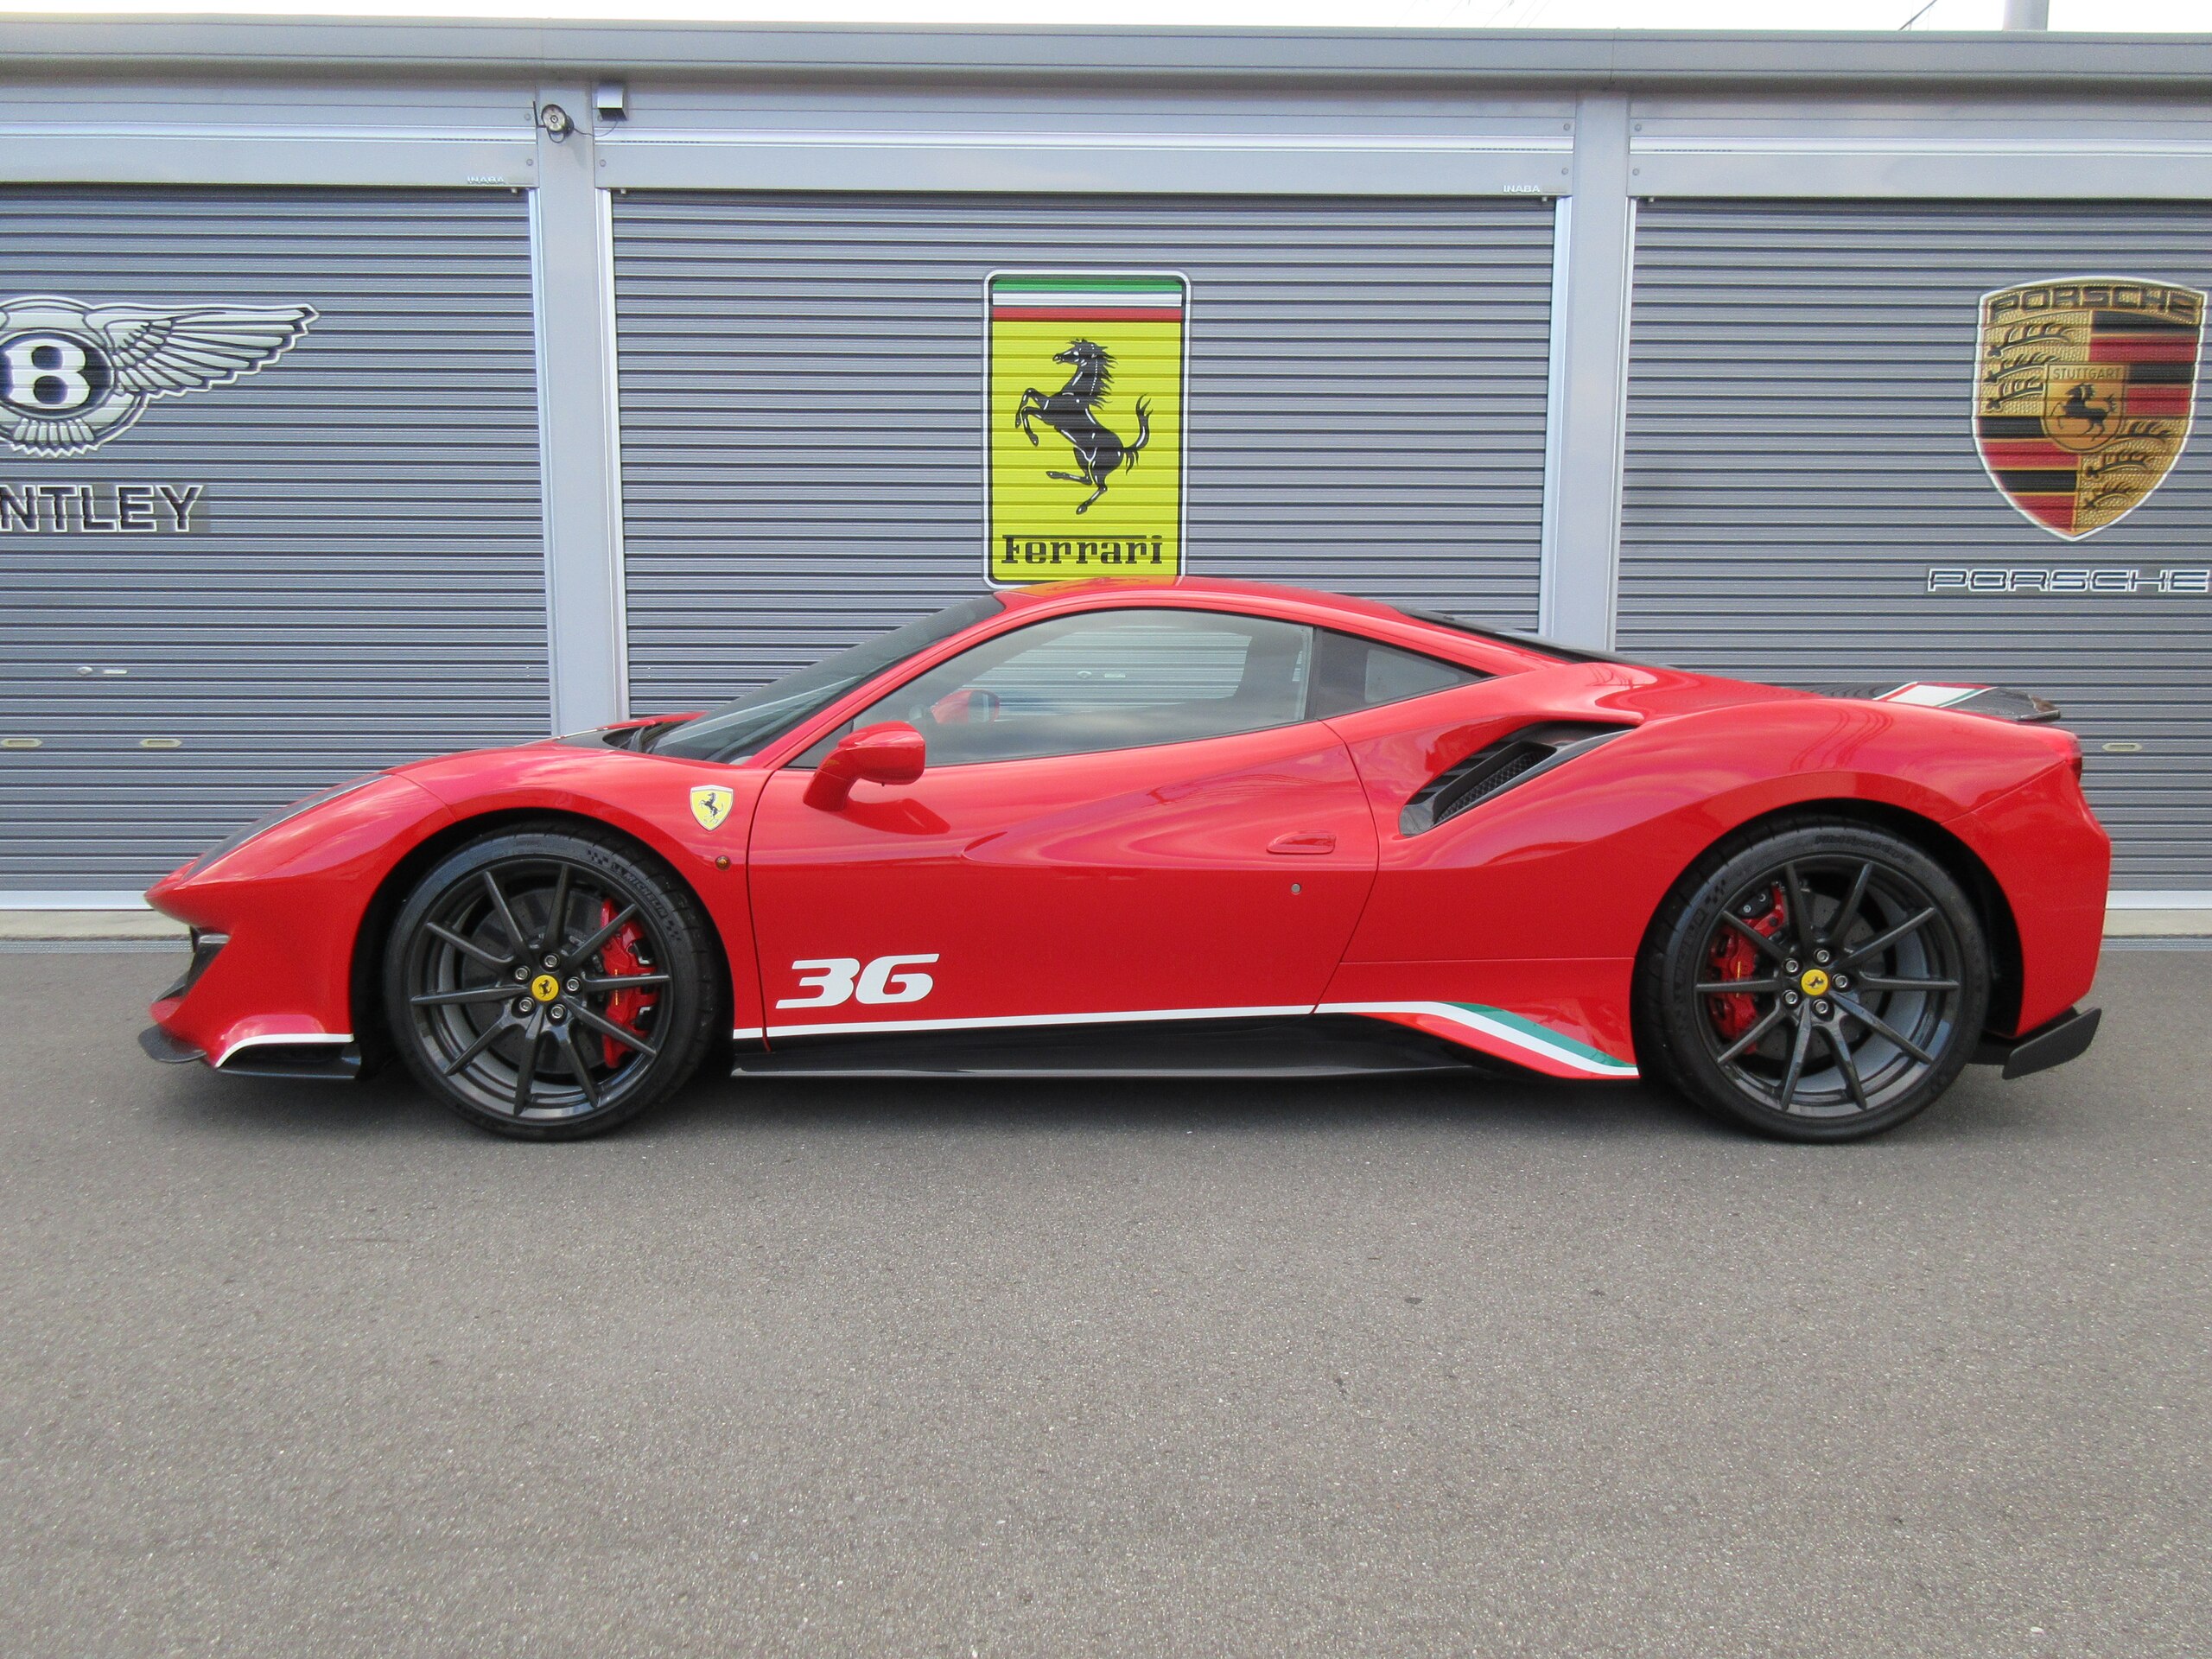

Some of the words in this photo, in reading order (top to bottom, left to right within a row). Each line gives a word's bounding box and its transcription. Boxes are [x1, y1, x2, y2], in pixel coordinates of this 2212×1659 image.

[467, 175, 505, 185] INABA
[1989, 286, 2197, 322] PORSCHE
[2052, 367, 2122, 380] STUTTGART
[0, 484, 204, 532] NTLEY
[1001, 534, 1163, 564] Ferrari
[1927, 568, 2210, 593] PORSCHE
[775, 953, 940, 1009] 36
